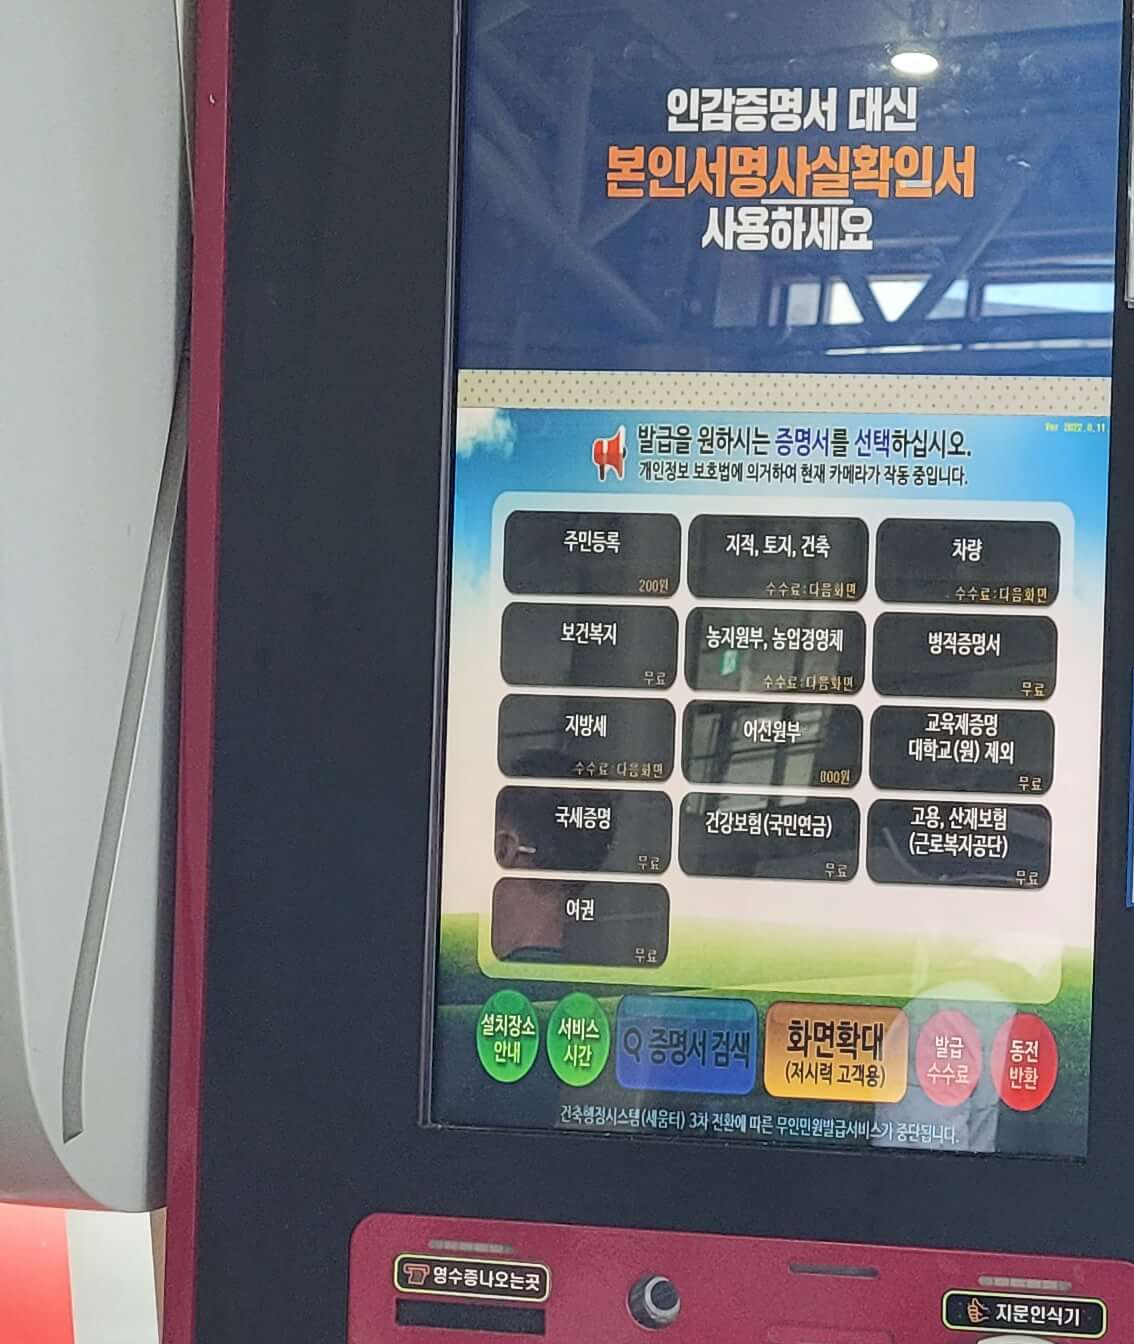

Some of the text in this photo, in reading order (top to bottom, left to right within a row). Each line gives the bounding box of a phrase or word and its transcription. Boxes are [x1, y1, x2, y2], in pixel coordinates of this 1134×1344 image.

[666, 87, 918, 133] 인감증명서 대신
[605, 145, 976, 199] 본인서명사실확인서
[701, 206, 873, 251] 사용하세요
[638, 425, 972, 458] 발급을 원하시는 증명서를 선택하십시오.
[639, 461, 968, 486] 개인정보 보호법에 의거하여 현재 카메라가 작동 중입니다.
[563, 530, 621, 554] 주민등록
[725, 533, 831, 558] 지적, 토지, 건축
[951, 538, 983, 562] 차량
[638, 577, 669, 594] 200원
[560, 622, 618, 646] 보건복지
[706, 625, 844, 652] 농지원부, 농업경영체
[928, 631, 1000, 656] 병적증명서
[643, 671, 666, 687] 무료
[1021, 682, 1046, 698] 무료
[565, 714, 607, 738] 지방세
[743, 720, 801, 744] 어선원부
[924, 712, 998, 737] 교육제증명
[908, 738, 1015, 764] 대학교(원) 제외
[1018, 775, 1042, 792] 무료
[555, 806, 612, 830] 국세증명
[705, 811, 833, 839] 건강보험(국민연금)
[910, 806, 1007, 831] 고용, 산재보험
[909, 832, 1009, 859] (근로복지공단)
[637, 855, 661, 871] 무료
[825, 862, 848, 878] 무료
[1015, 869, 1039, 886] 무료
[566, 898, 595, 921] 여권
[634, 947, 657, 963] 무료
[481, 1014, 536, 1038] 설치장소
[558, 1017, 600, 1040] 서비스
[494, 1040, 521, 1064] 안내
[649, 1027, 751, 1070] 증명서 검색
[786, 1019, 885, 1062] 화면확대
[935, 1035, 965, 1060] 발급
[1009, 1040, 1039, 1064] 동전
[563, 1045, 593, 1068] 시간
[785, 1060, 886, 1089] (저시력 고객용)
[927, 1063, 970, 1086] 수수료
[1009, 1067, 1039, 1091] 반환
[559, 1105, 960, 1145] 건축행정시스템(세움터) 3차 전환에 따른 무인민원발급서비스가 중단됩니다.
[433, 1266, 540, 1292] 영수증나오는곳
[996, 1303, 1081, 1327] 지문인식기
